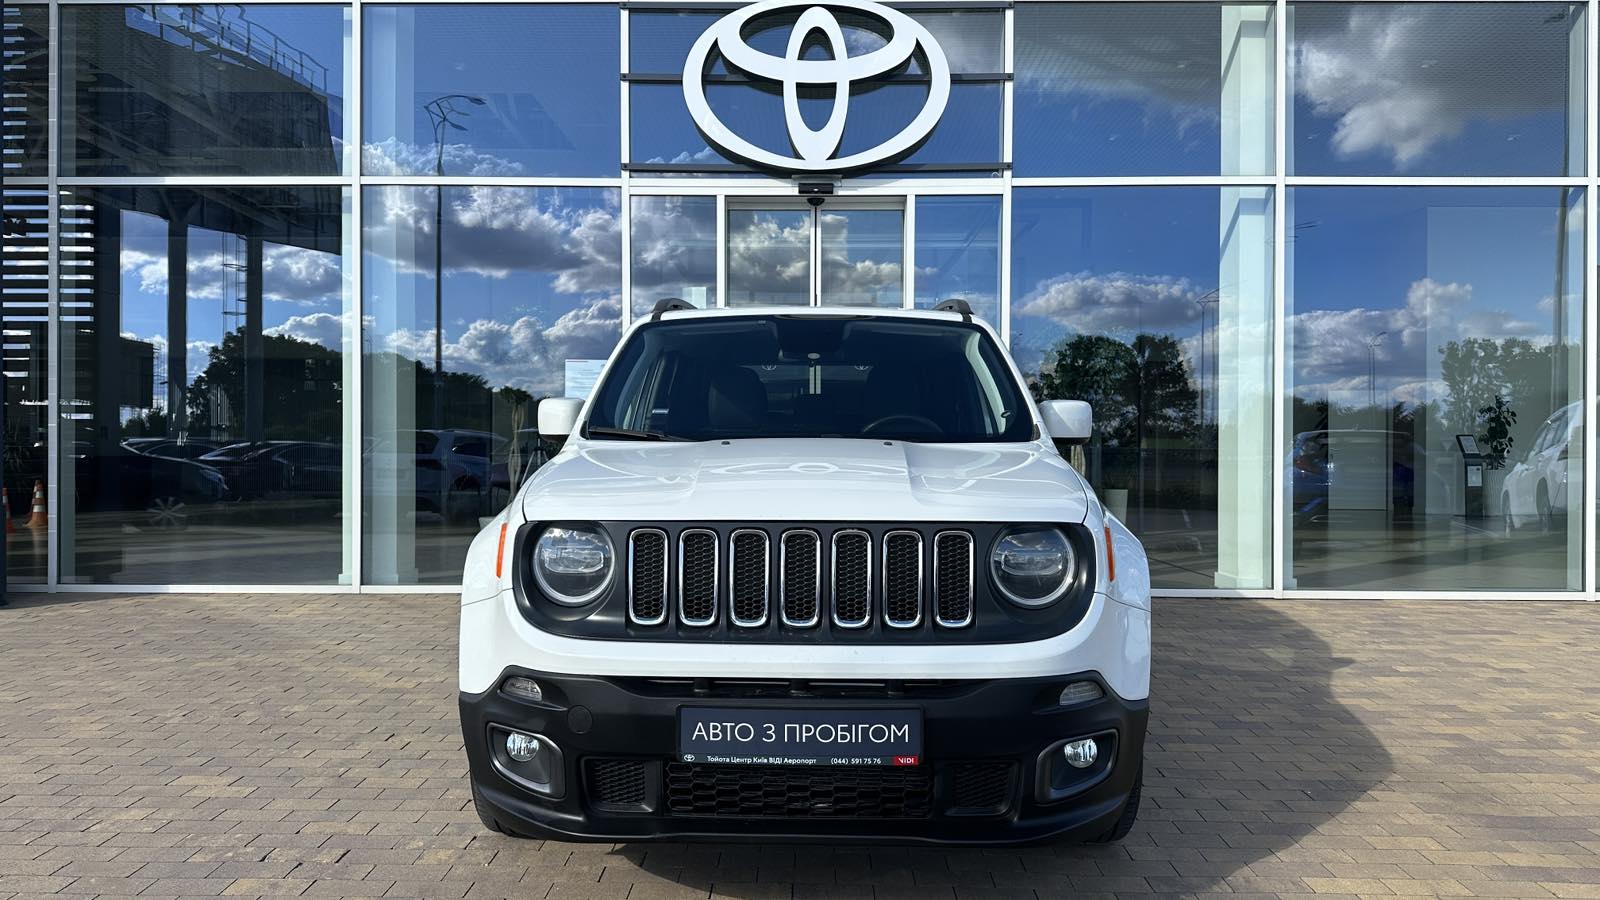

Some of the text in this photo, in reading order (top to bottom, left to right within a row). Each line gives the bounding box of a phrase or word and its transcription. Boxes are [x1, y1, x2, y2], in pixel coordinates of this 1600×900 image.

[692, 722, 755, 742] АВТО
[784, 724, 909, 743] ПРОБІГОМ
[706, 755, 730, 763] Тойота
[731, 756, 752, 764] Центр
[753, 756, 768, 764] Київ
[783, 757, 817, 765] Аеропорт
[830, 757, 882, 765] (044) 591 75 76
